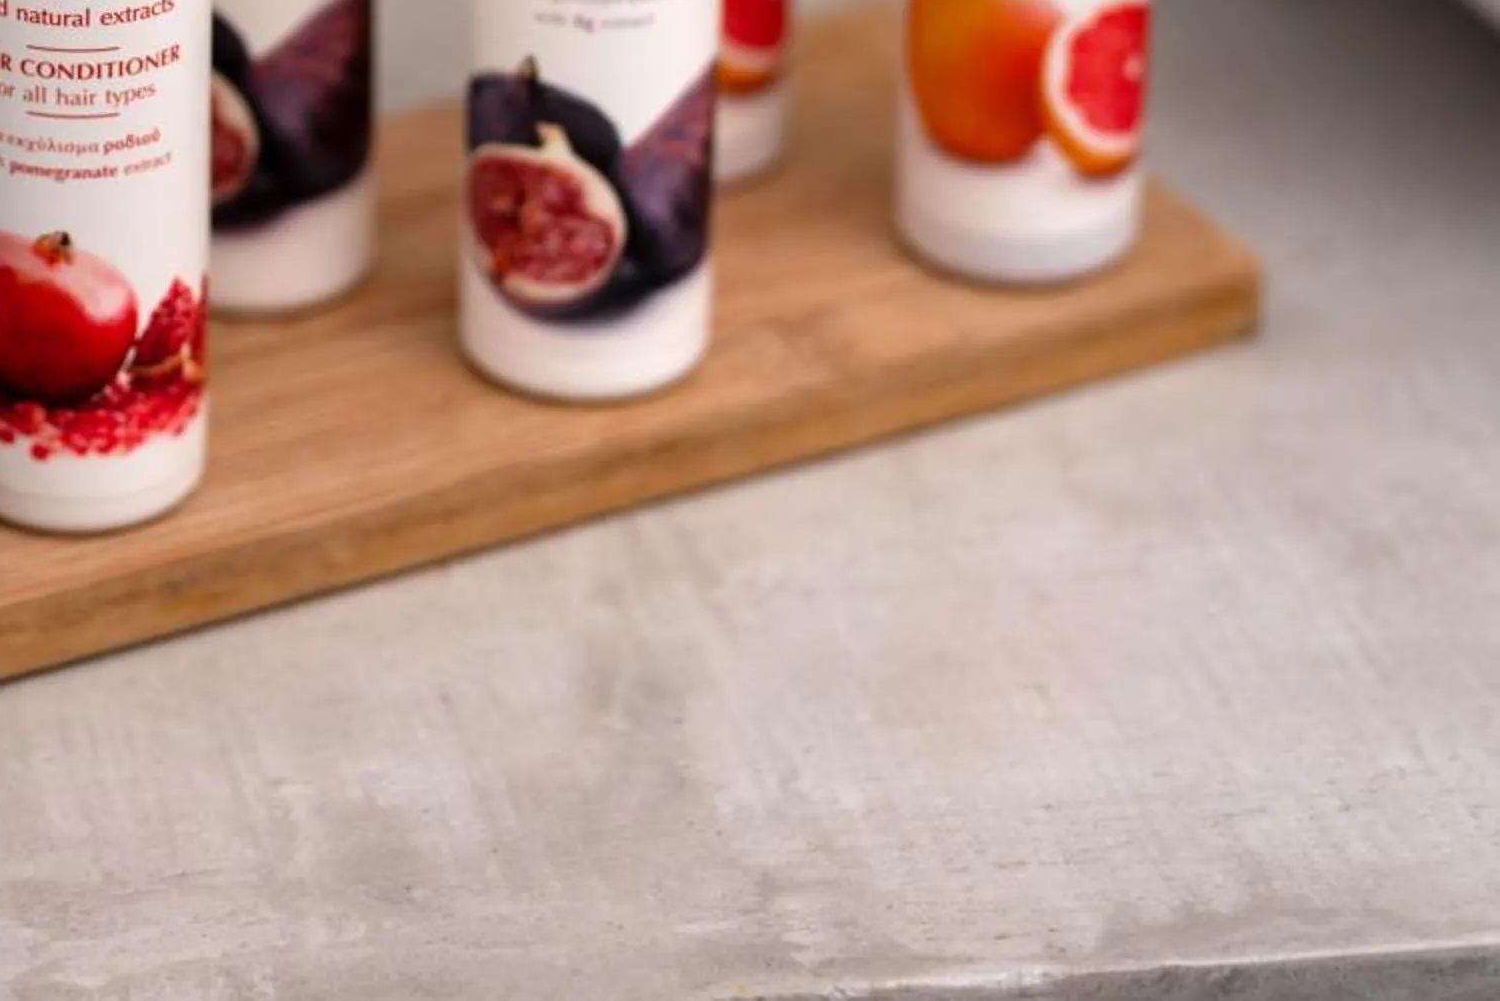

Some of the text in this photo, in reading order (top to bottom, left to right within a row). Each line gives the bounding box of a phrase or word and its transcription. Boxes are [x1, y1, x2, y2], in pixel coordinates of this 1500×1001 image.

[16, 7, 91, 28] natural
[20, 43, 181, 81] CONDITIONER
[23, 85, 47, 104] all
[55, 87, 96, 106] hair
[105, 82, 156, 108] types
[9, 161, 118, 183] pomegranate
